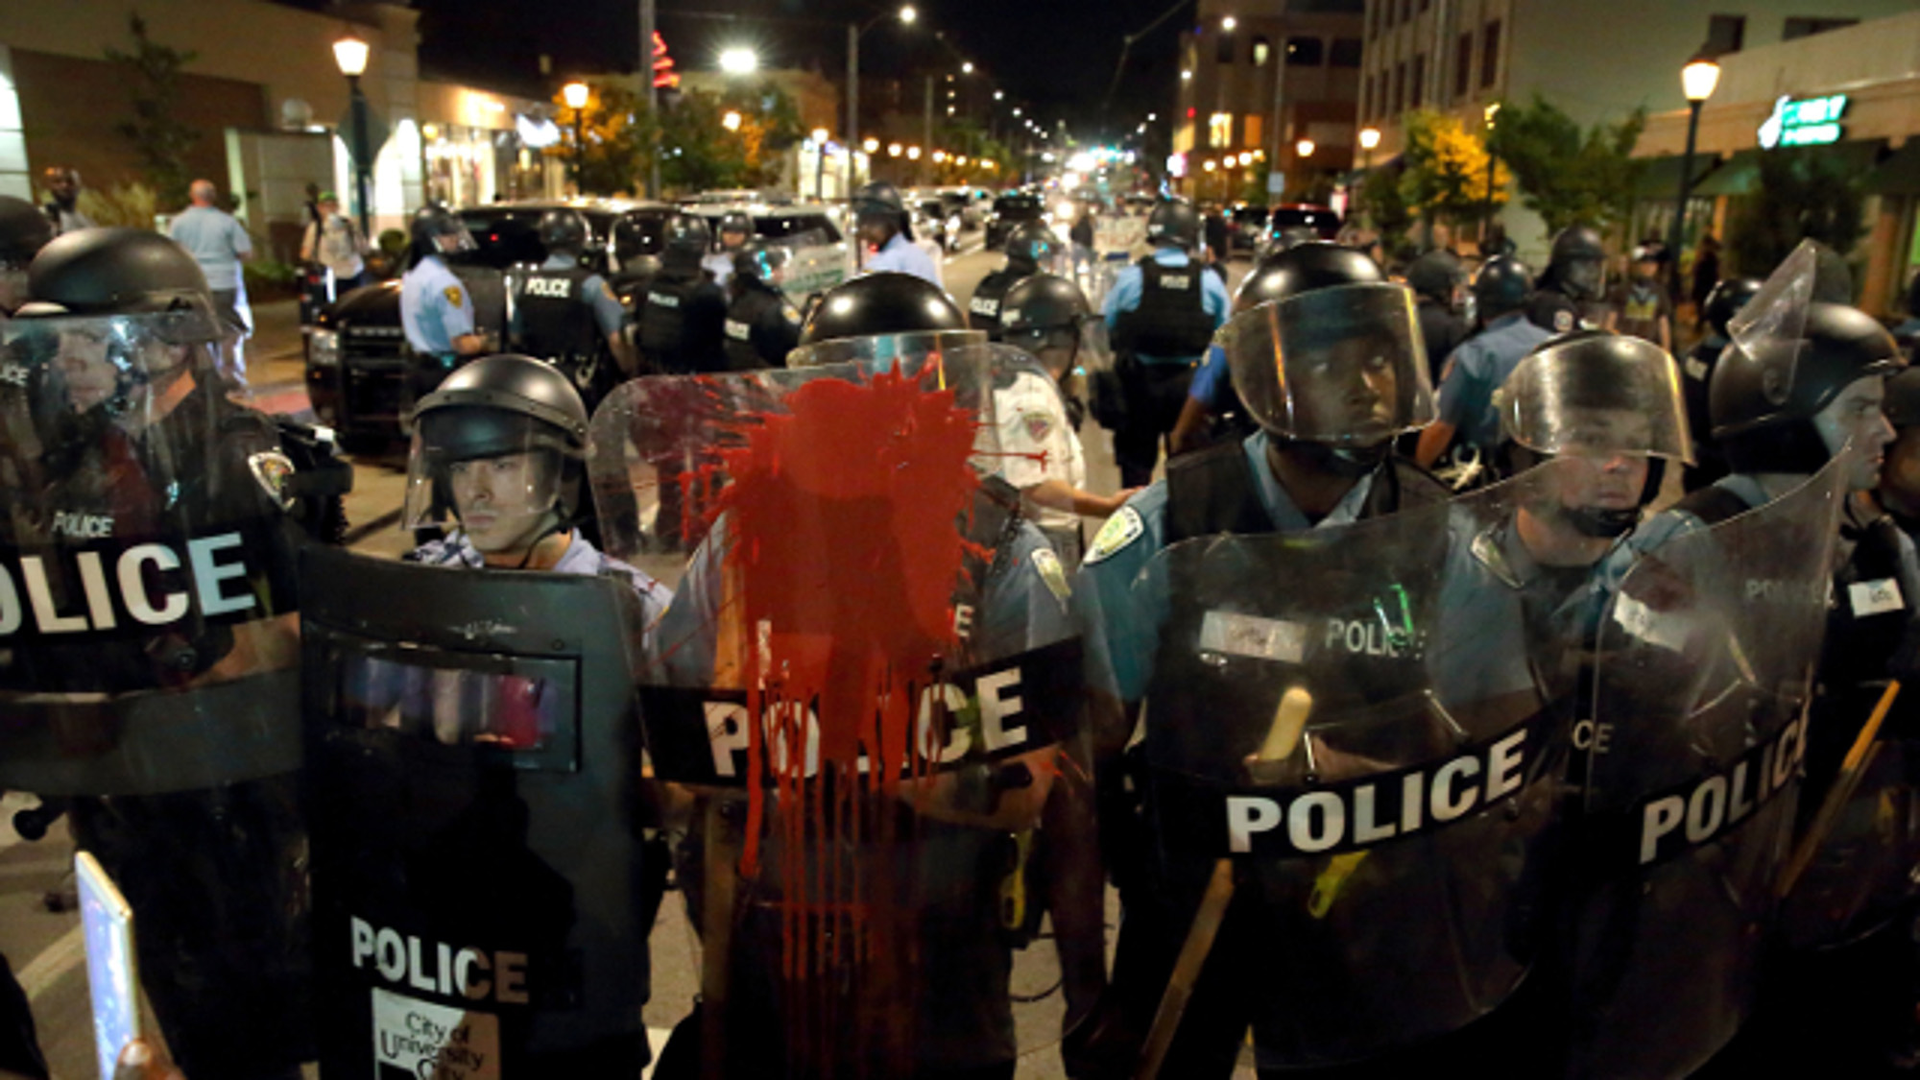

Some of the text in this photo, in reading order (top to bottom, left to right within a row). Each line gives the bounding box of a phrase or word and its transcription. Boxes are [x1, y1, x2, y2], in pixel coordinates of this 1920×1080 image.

[525, 277, 571, 298] POLICE
[52, 511, 114, 538] POLICE
[702, 667, 1027, 778] POCE
[1226, 728, 1528, 854] POLICE
[351, 915, 529, 1005] POLICE
[404, 1010, 446, 1044] City
[380, 1029, 483, 1072] University
